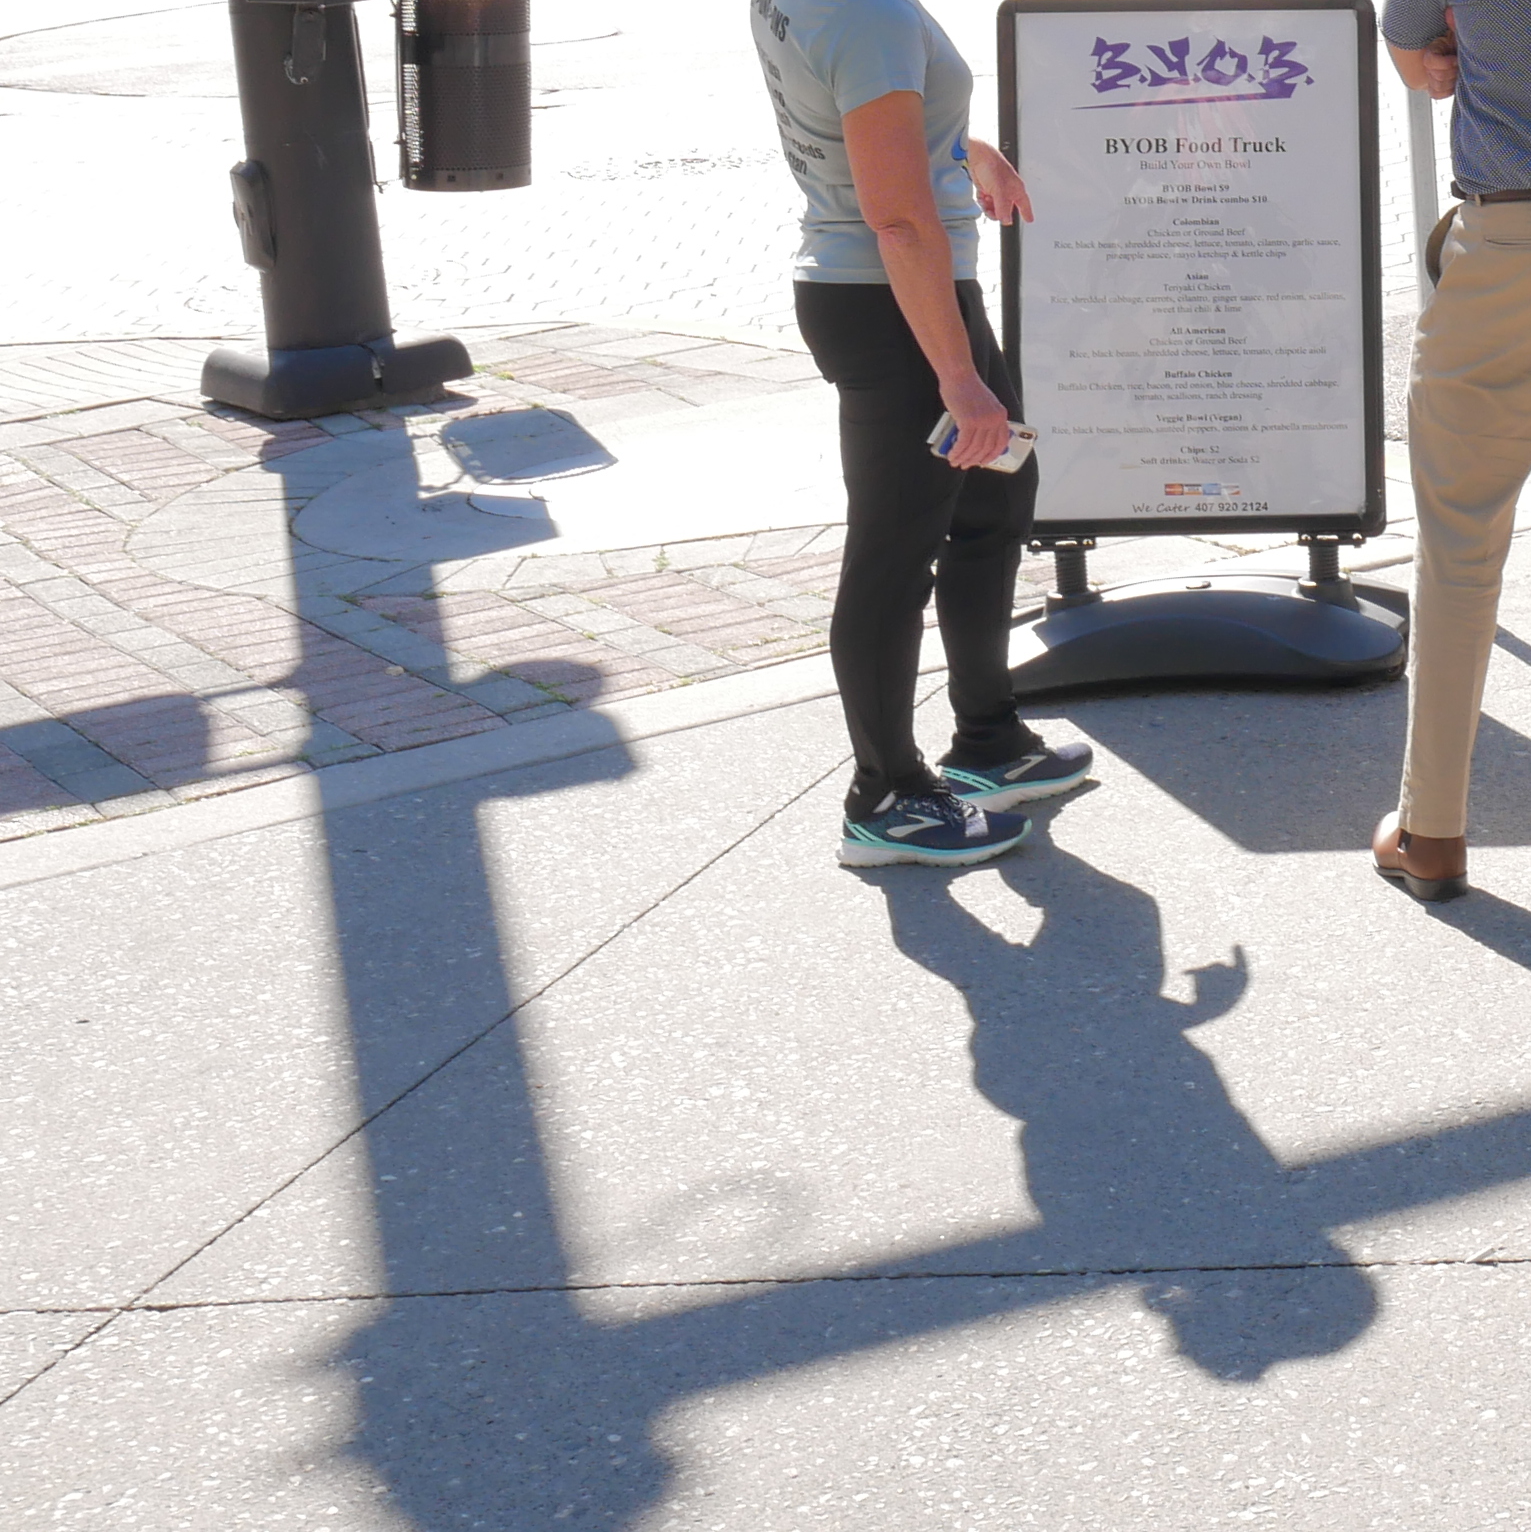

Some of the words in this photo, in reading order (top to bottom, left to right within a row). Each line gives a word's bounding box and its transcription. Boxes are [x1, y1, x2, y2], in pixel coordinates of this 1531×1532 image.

[1086, 34, 1316, 100] B.Y.O.B.
[1106, 138, 1167, 153] BYOB
[1176, 138, 1222, 153] Food
[1229, 137, 1286, 152] Truck
[1140, 161, 1167, 170] Build
[1170, 160, 1194, 169] Your
[1197, 160, 1221, 169] Own
[1225, 160, 1250, 168] Bowl
[1147, 229, 1181, 237] Chicken
[1227, 228, 1245, 236] Beef
[1054, 241, 1073, 249] Rice,
[1125, 240, 1160, 248] shredded
[1292, 239, 1314, 248] garlic
[1198, 250, 1230, 259] ketchup
[1231, 250, 1239, 259] &
[1241, 250, 1264, 259] kettle
[1265, 250, 1286, 259] chips
[1197, 283, 1231, 291] Chicken
[1051, 296, 1069, 304] Rice,
[1071, 295, 1106, 303] shredded
[1109, 296, 1144, 305] cabbage,
[1266, 293, 1279, 301] red
[1149, 338, 1183, 346] Chicken
[1069, 350, 1090, 358] Rice,
[1275, 347, 1307, 356] chipotle
[1309, 346, 1326, 354] aioli
[1058, 383, 1087, 391] Buffalo
[1175, 381, 1188, 389] red
[1267, 380, 1302, 388] shredded
[1134, 393, 1164, 401] tomato,
[1230, 392, 1262, 400] dressing
[1156, 415, 1183, 423] Veggie
[1209, 414, 1242, 422] (Vegan)
[1052, 426, 1071, 434] Rice,
[1073, 426, 1094, 434] black
[1096, 426, 1122, 434] beans,
[1123, 426, 1154, 434] tomato,
[1261, 423, 1300, 432] portabella
[1132, 503, 1152, 513] We
[1156, 503, 1190, 512] Cater
[1195, 503, 1214, 512] 407
[1218, 502, 1238, 511] 920
[1242, 502, 1268, 511] 2124
